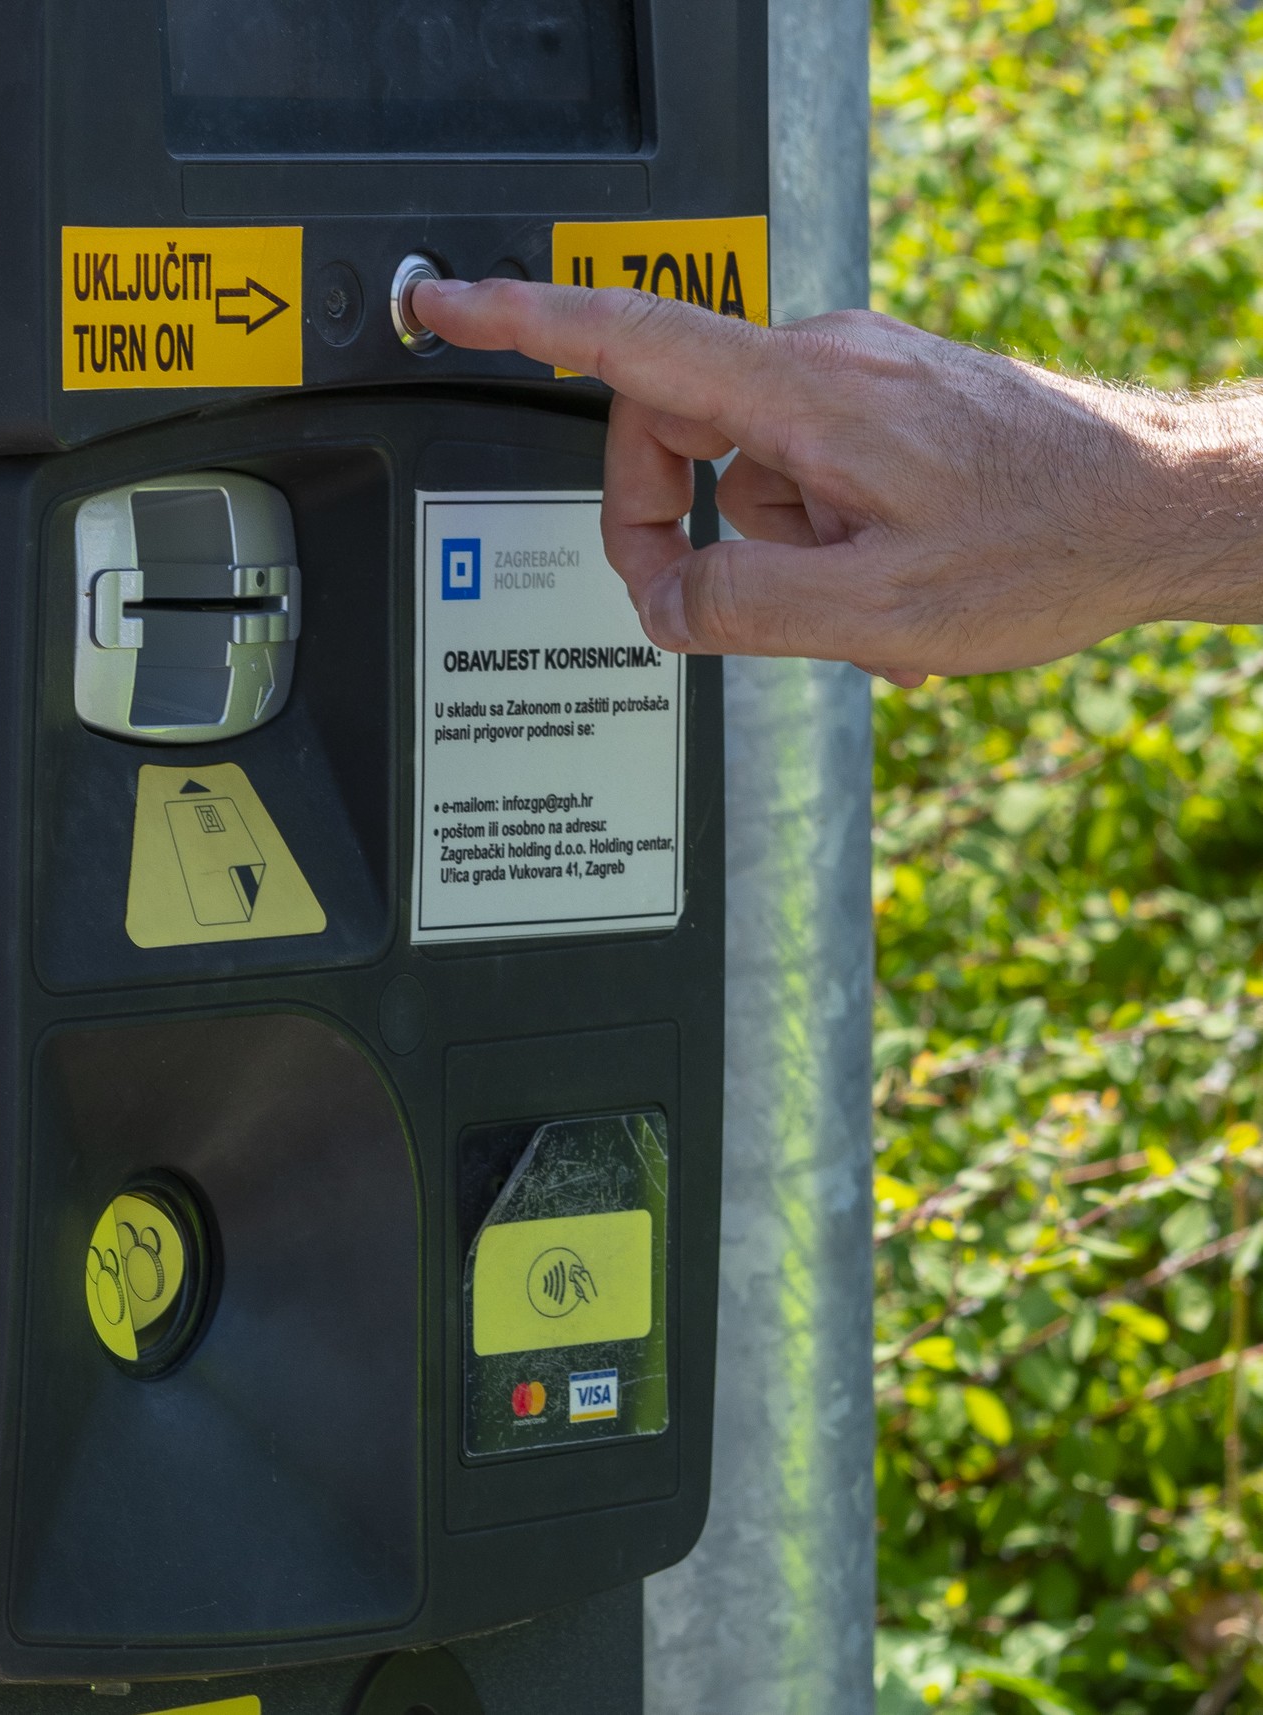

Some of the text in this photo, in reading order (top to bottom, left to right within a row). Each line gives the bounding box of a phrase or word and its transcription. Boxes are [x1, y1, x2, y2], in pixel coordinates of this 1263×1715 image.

[73, 242, 213, 302] UKLJUČITI
[73, 324, 194, 372] TURN ON
[494, 547, 580, 568] ZAGREBAČKI
[494, 572, 556, 590] HOLDING
[443, 645, 661, 672] OBAVIJEST KORISNICIMA:
[435, 702, 444, 719] U
[447, 702, 487, 718] skladu
[489, 704, 504, 717] sa
[506, 700, 561, 716] Zakonom
[564, 702, 573, 714] o
[574, 697, 610, 714] zaštiti
[434, 721, 595, 745] pisani prigovor podnosi se:
[441, 793, 594, 814] e-mailom: infozgp@zgh.hr
[441, 818, 607, 843] poštom ili osobno na adresu:
[440, 836, 675, 864] Zagrebački holding d.o.o. Holding centar,
[472, 866, 506, 886] grada
[508, 864, 563, 880] Vukovara
[565, 861, 582, 879] 41,
[585, 859, 625, 879] Zagreb
[575, 1384, 611, 1407] VISA
